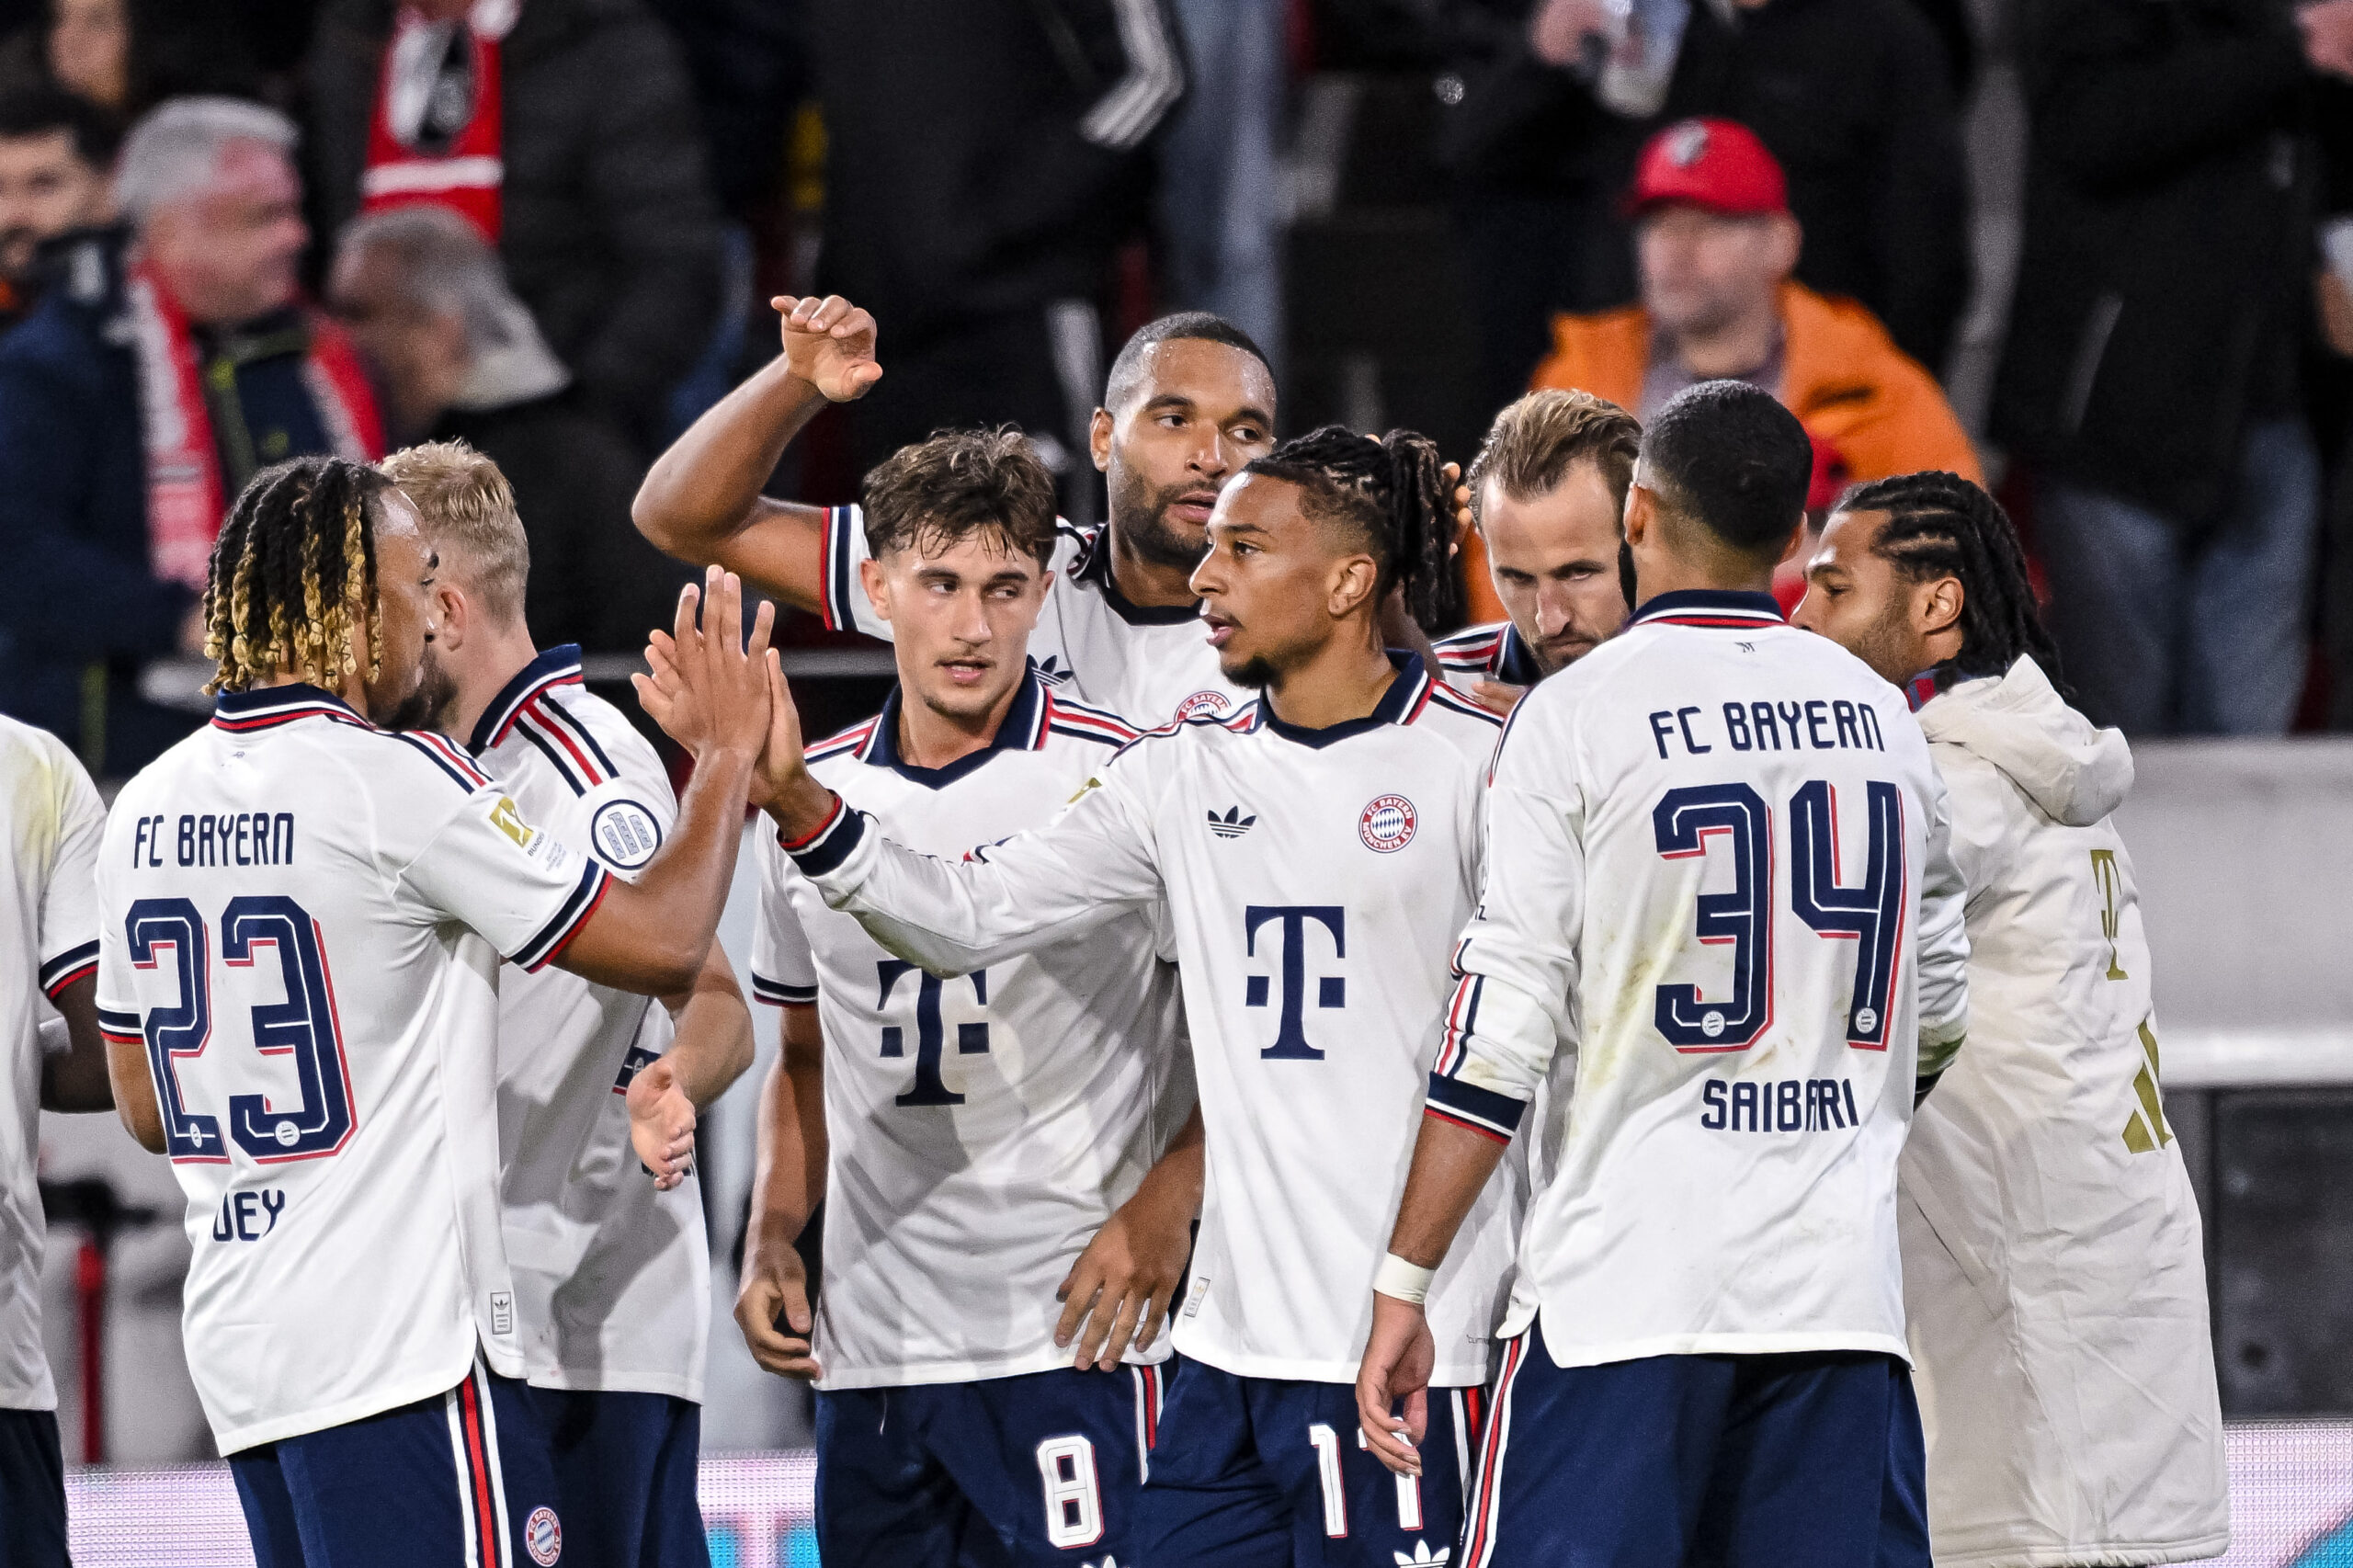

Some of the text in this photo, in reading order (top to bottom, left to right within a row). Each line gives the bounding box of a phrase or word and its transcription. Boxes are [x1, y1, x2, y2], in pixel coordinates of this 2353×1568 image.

[1649, 699, 1885, 759] FC BAYERN
[133, 812, 294, 869] FC BAYERN
[1366, 799, 1414, 820] FC BAYERN
[1652, 779, 1908, 1054] 34
[2089, 848, 2129, 981] T
[124, 895, 359, 1165] 23
[877, 959, 991, 1107] T
[1245, 904, 1347, 1061] T
[1700, 1078, 1859, 1132] SAIBARI
[1036, 1435, 1105, 1551] 8
[1309, 1416, 1424, 1539] 11
